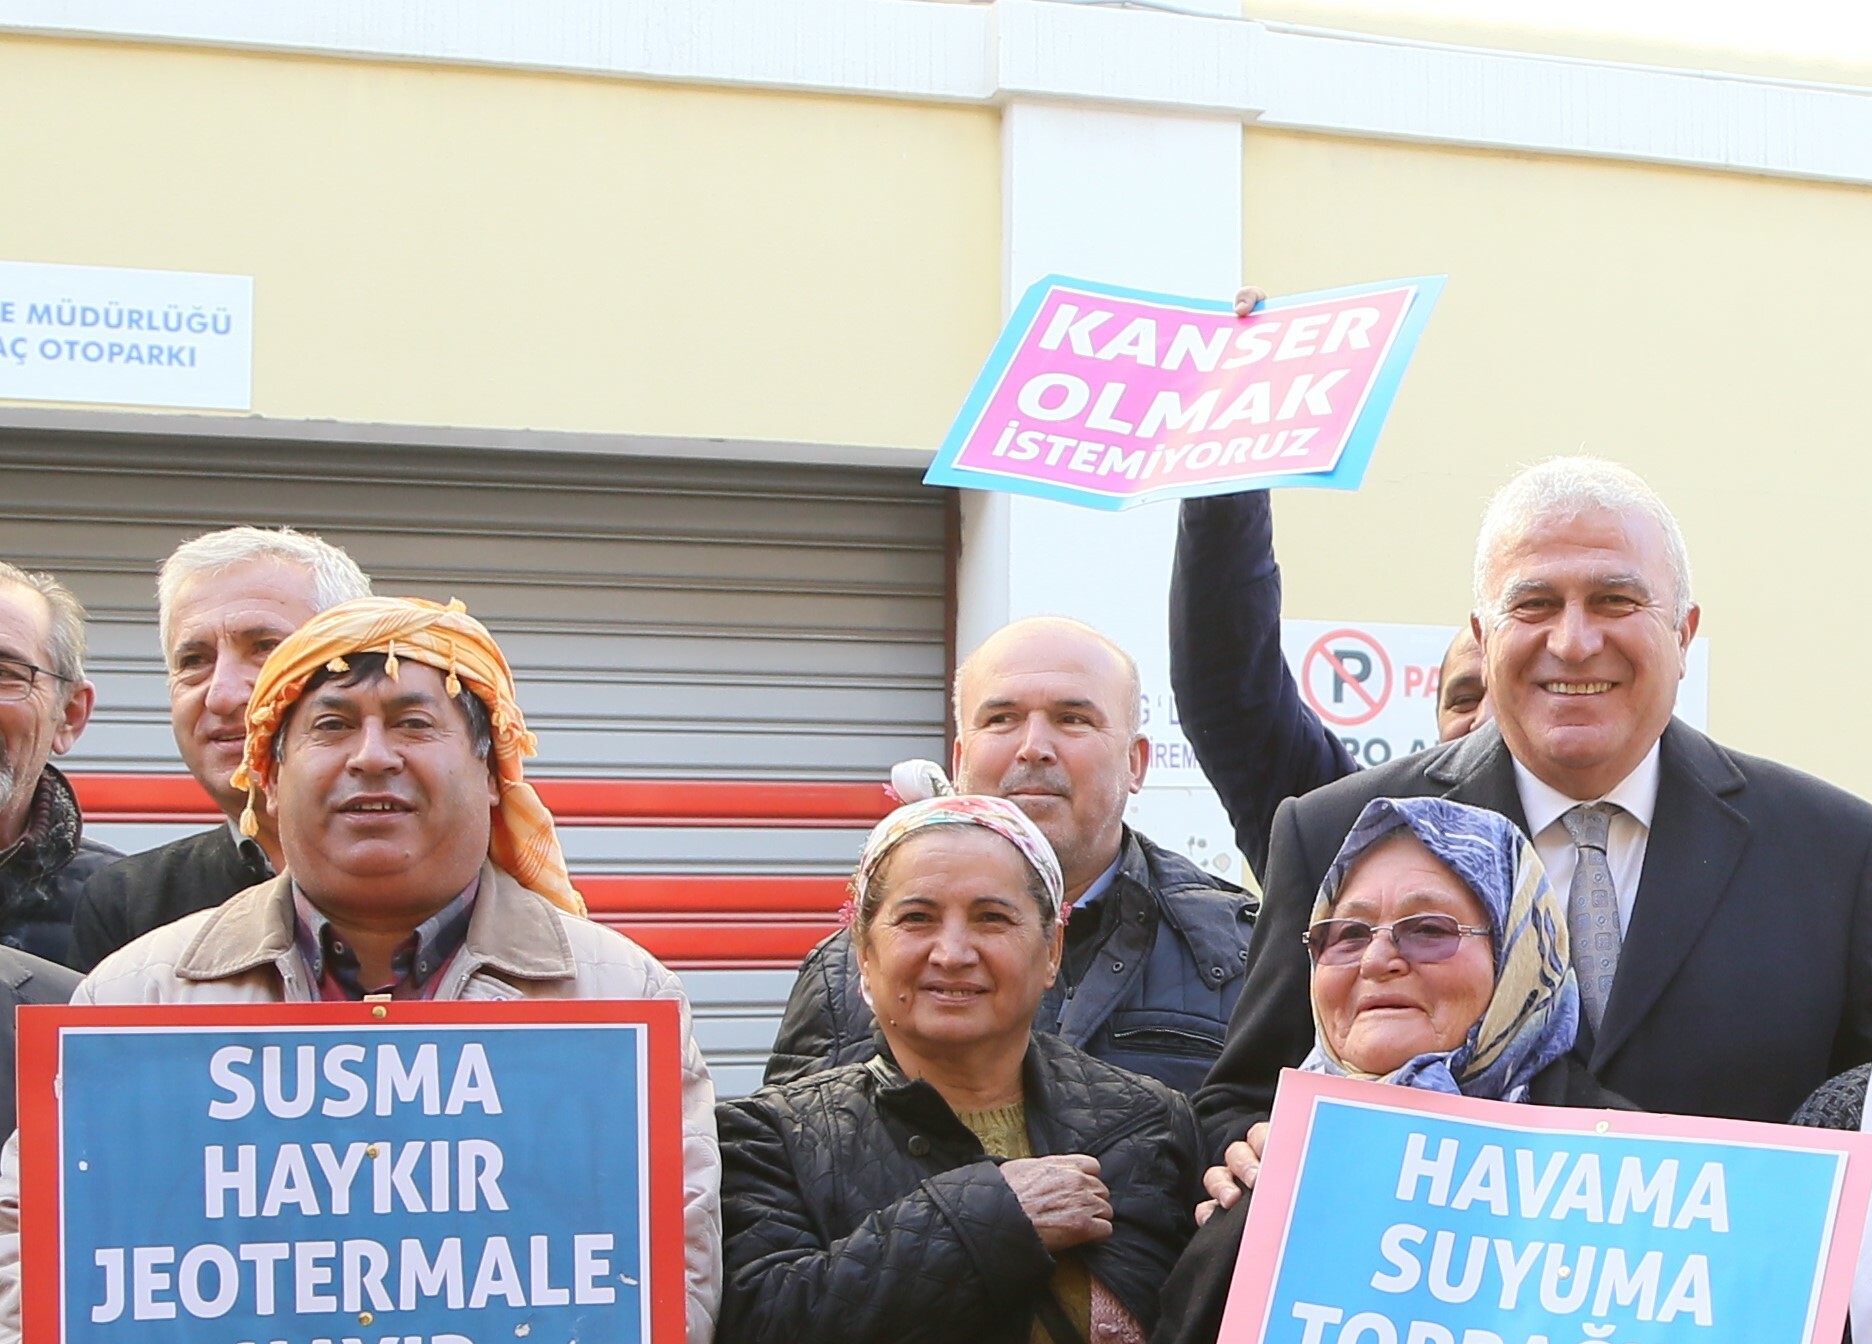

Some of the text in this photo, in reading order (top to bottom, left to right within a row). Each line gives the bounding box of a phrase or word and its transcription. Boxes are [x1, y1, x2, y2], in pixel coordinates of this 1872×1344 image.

[26, 298, 233, 336] MÜDÜRLÜĞÜ
[39, 338, 197, 367] OTOPARKI
[1038, 303, 1381, 372] KANSER
[1016, 369, 1352, 439] OLMAK
[992, 420, 1321, 480] İSTEMİYORUZ
[208, 1043, 502, 1120] SUSMA
[204, 1138, 509, 1219] HAYKIR
[1396, 1133, 1729, 1233] HAVAMA
[91, 1233, 615, 1324] JEOTERMALE
[1370, 1223, 1713, 1326] SUYUMA
